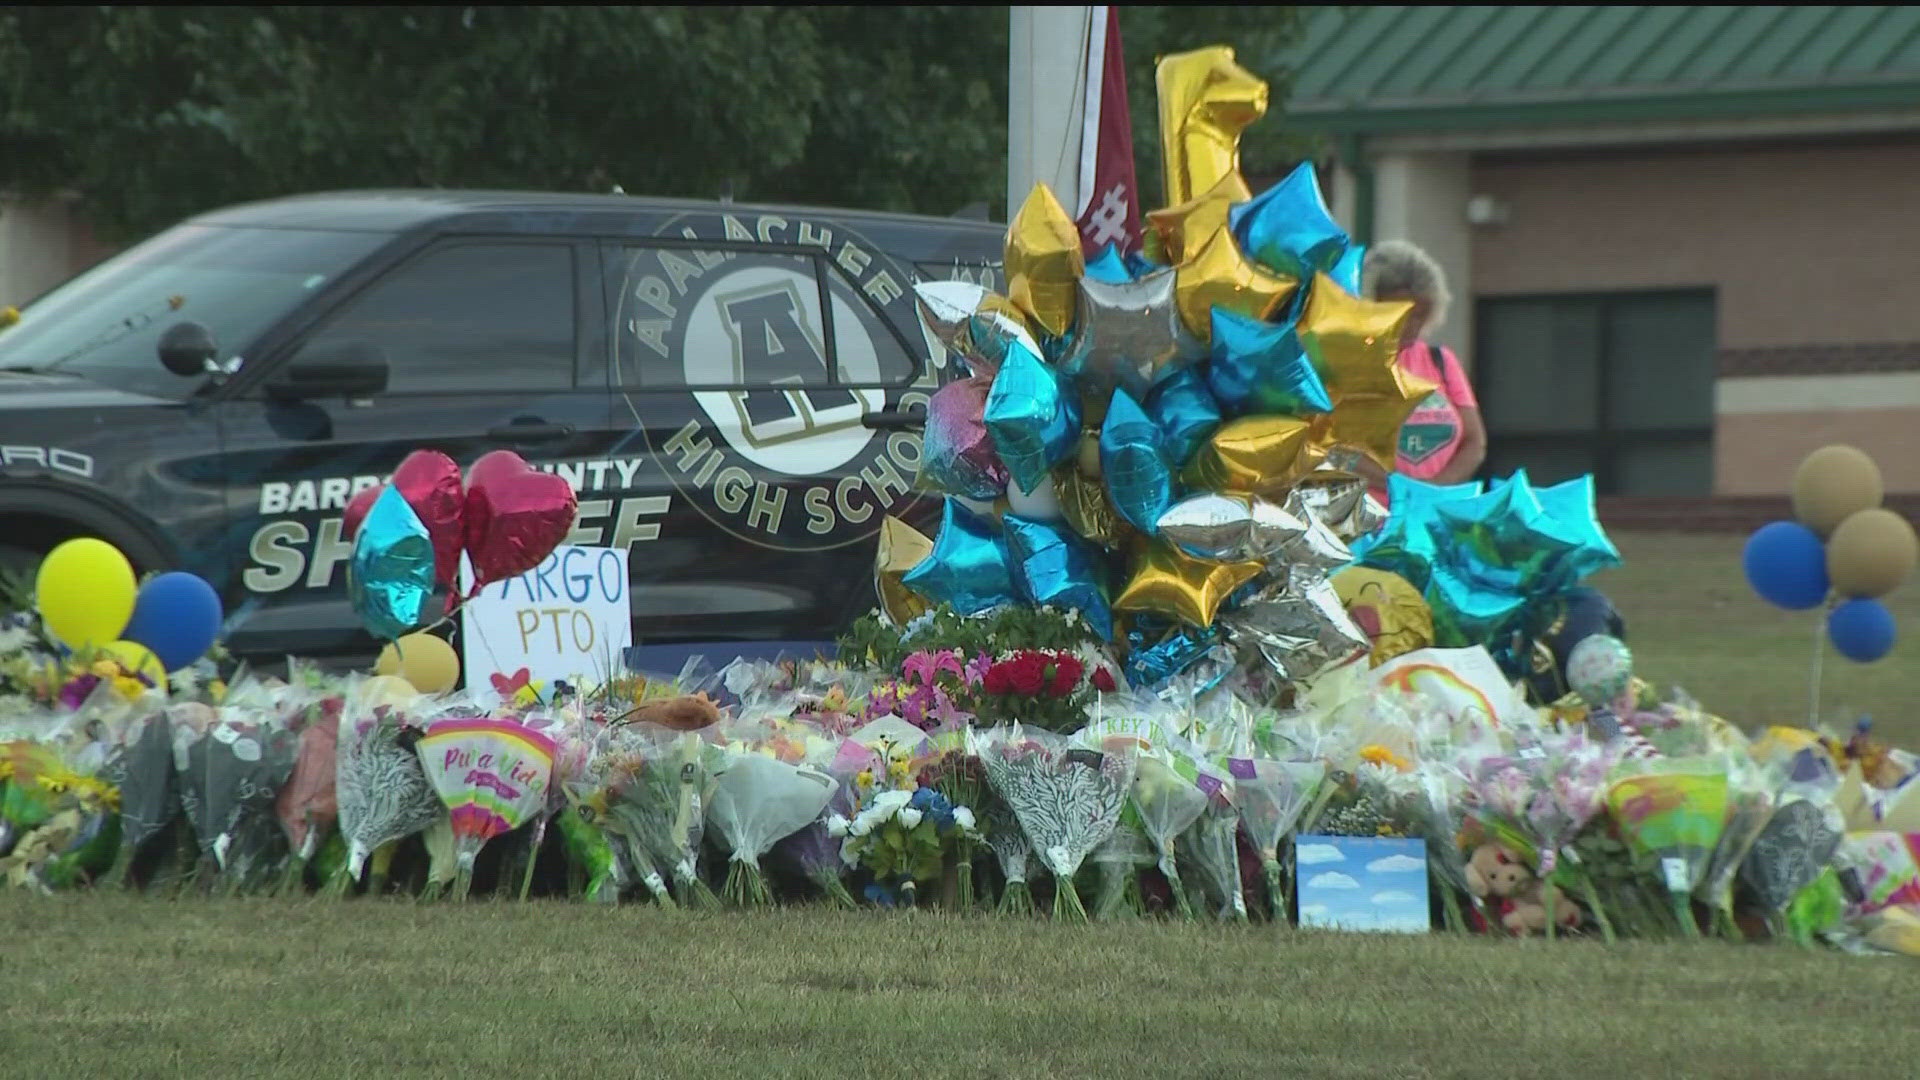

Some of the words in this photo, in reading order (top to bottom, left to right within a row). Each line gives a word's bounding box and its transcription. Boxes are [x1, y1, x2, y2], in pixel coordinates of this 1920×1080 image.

[628, 213, 903, 359] APALACHEE
[0, 445, 94, 478] RO
[662, 419, 788, 534] HIGH
[243, 495, 672, 593] SHFF
[517, 608, 595, 655] PTO
